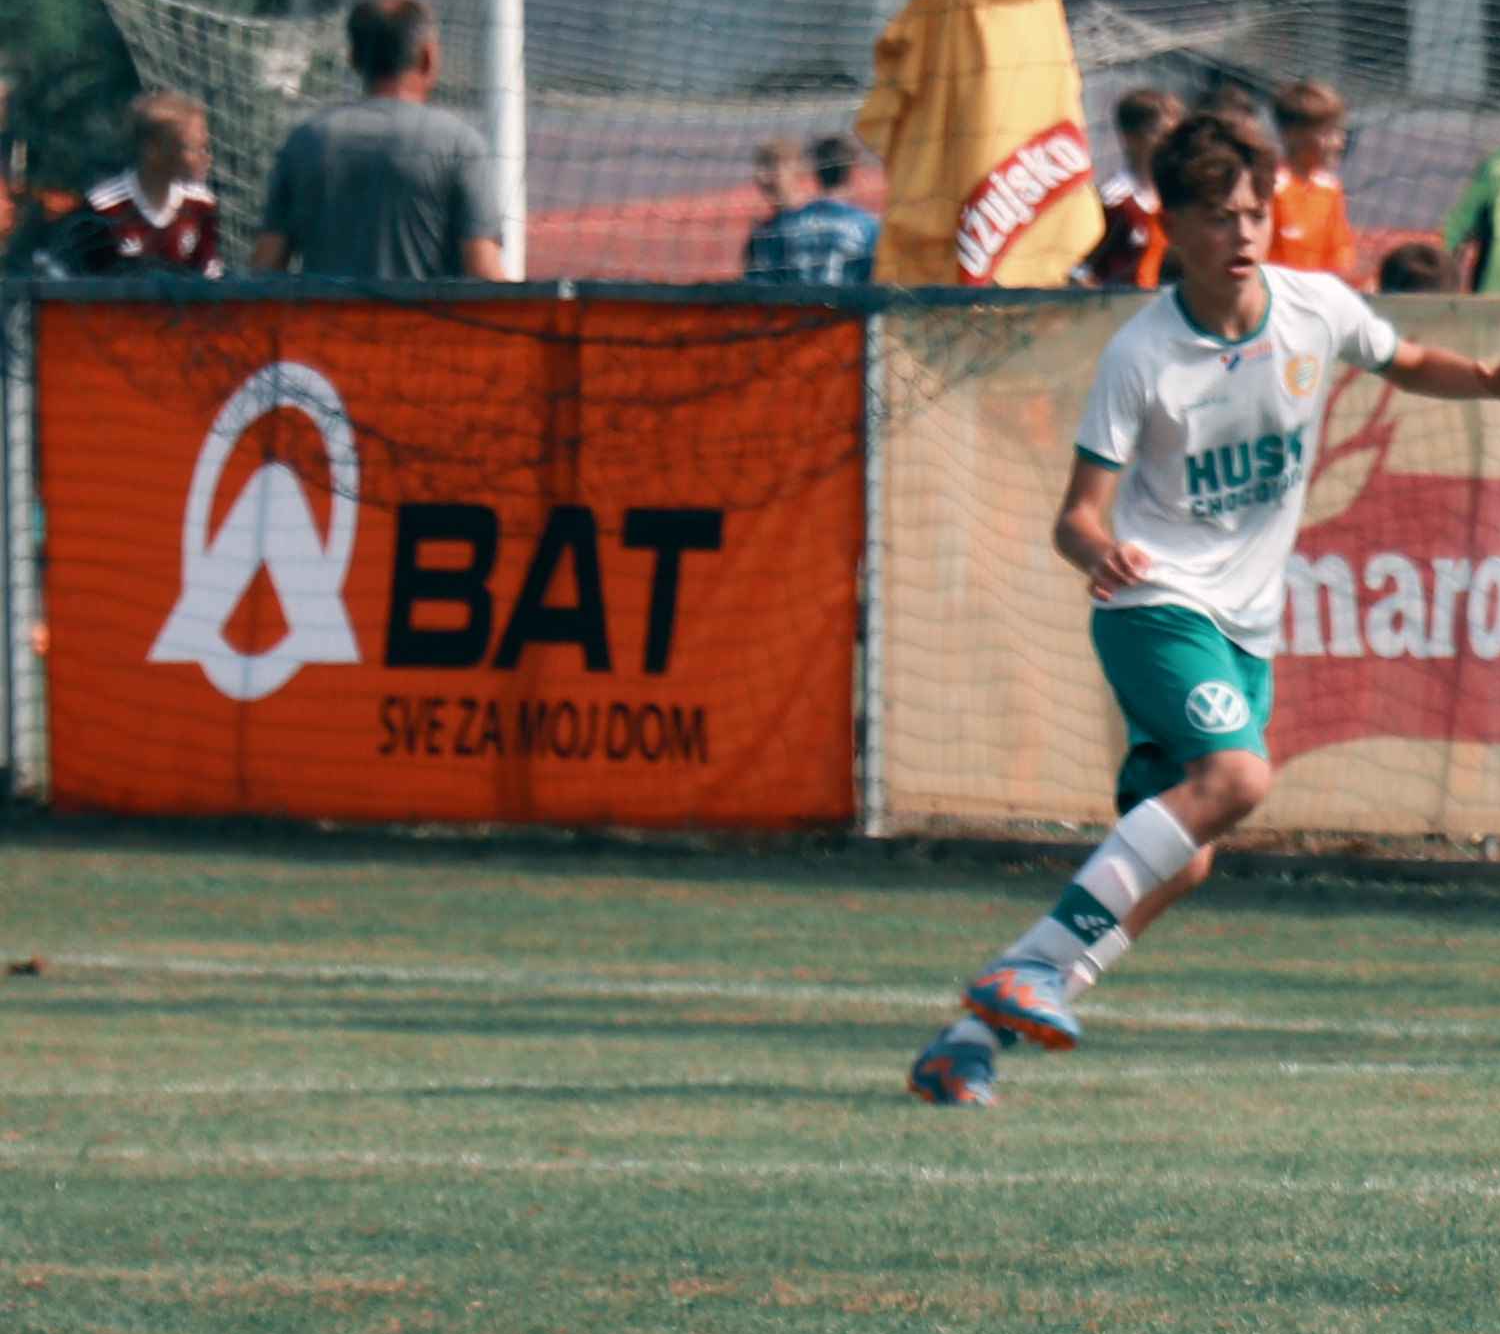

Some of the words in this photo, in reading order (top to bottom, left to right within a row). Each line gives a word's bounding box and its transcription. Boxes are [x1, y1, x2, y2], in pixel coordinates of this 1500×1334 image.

[385, 503, 724, 675] BAT
[379, 694, 446, 757] SVE
[454, 696, 504, 758] ZA
[514, 698, 598, 761] MOJ
[606, 700, 709, 764] DOM
